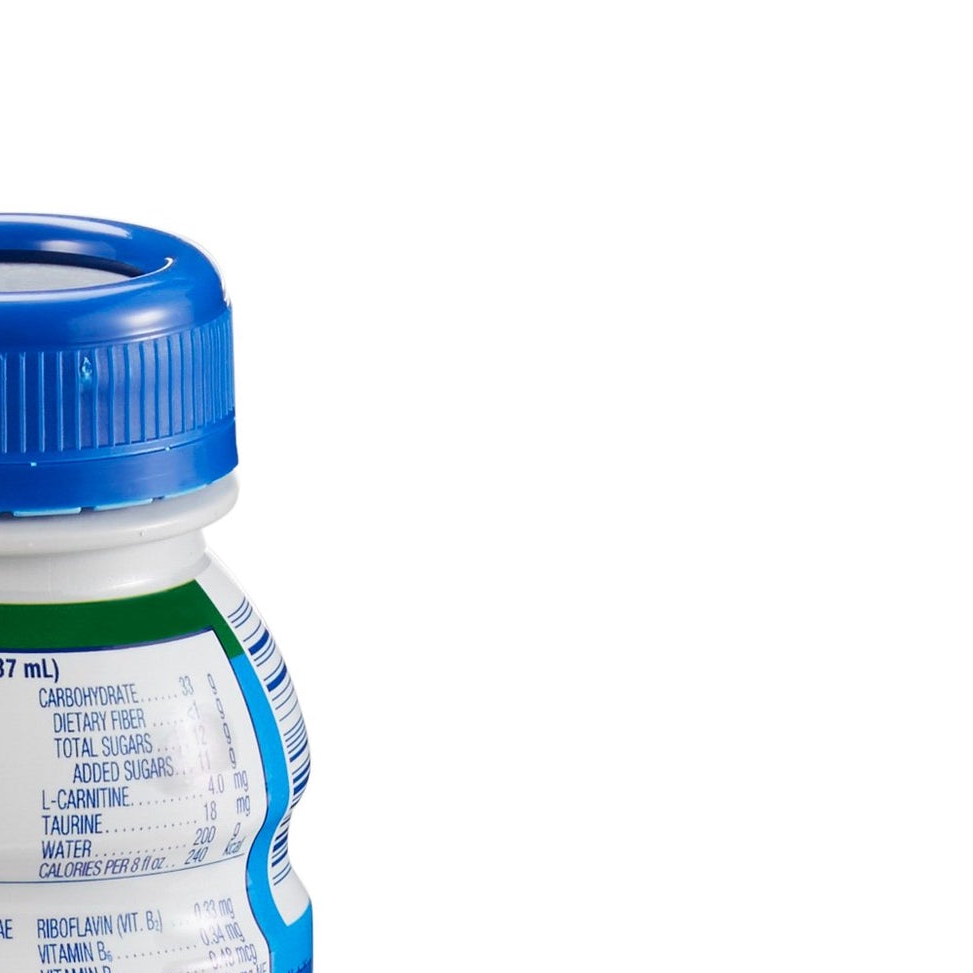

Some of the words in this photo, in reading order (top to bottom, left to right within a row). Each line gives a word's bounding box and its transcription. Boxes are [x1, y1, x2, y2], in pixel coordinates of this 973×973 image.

[24, 659, 59, 683] mL)
[39, 684, 138, 708] CARBOHYDRATE
[179, 676, 194, 696] 33
[53, 713, 107, 733] DIETARY
[111, 708, 146, 730] FIBER
[55, 737, 98, 758] TOTAL
[102, 734, 153, 755] SUGARS
[73, 762, 119, 783] ADDED
[124, 756, 174, 781] SUGARS
[42, 786, 130, 810] L-CARNITINE
[42, 813, 103, 835] TAURINE
[203, 802, 216, 821] 18
[42, 840, 91, 859] WATER
[193, 826, 216, 846] 200
[39, 859, 103, 879] CALORIES
[104, 858, 127, 874] PER
[130, 857, 140, 872] 8
[141, 856, 149, 871] fl
[150, 857, 165, 870] oz
[184, 846, 209, 865] 240
[37, 918, 113, 939] RIBOFLAVIN
